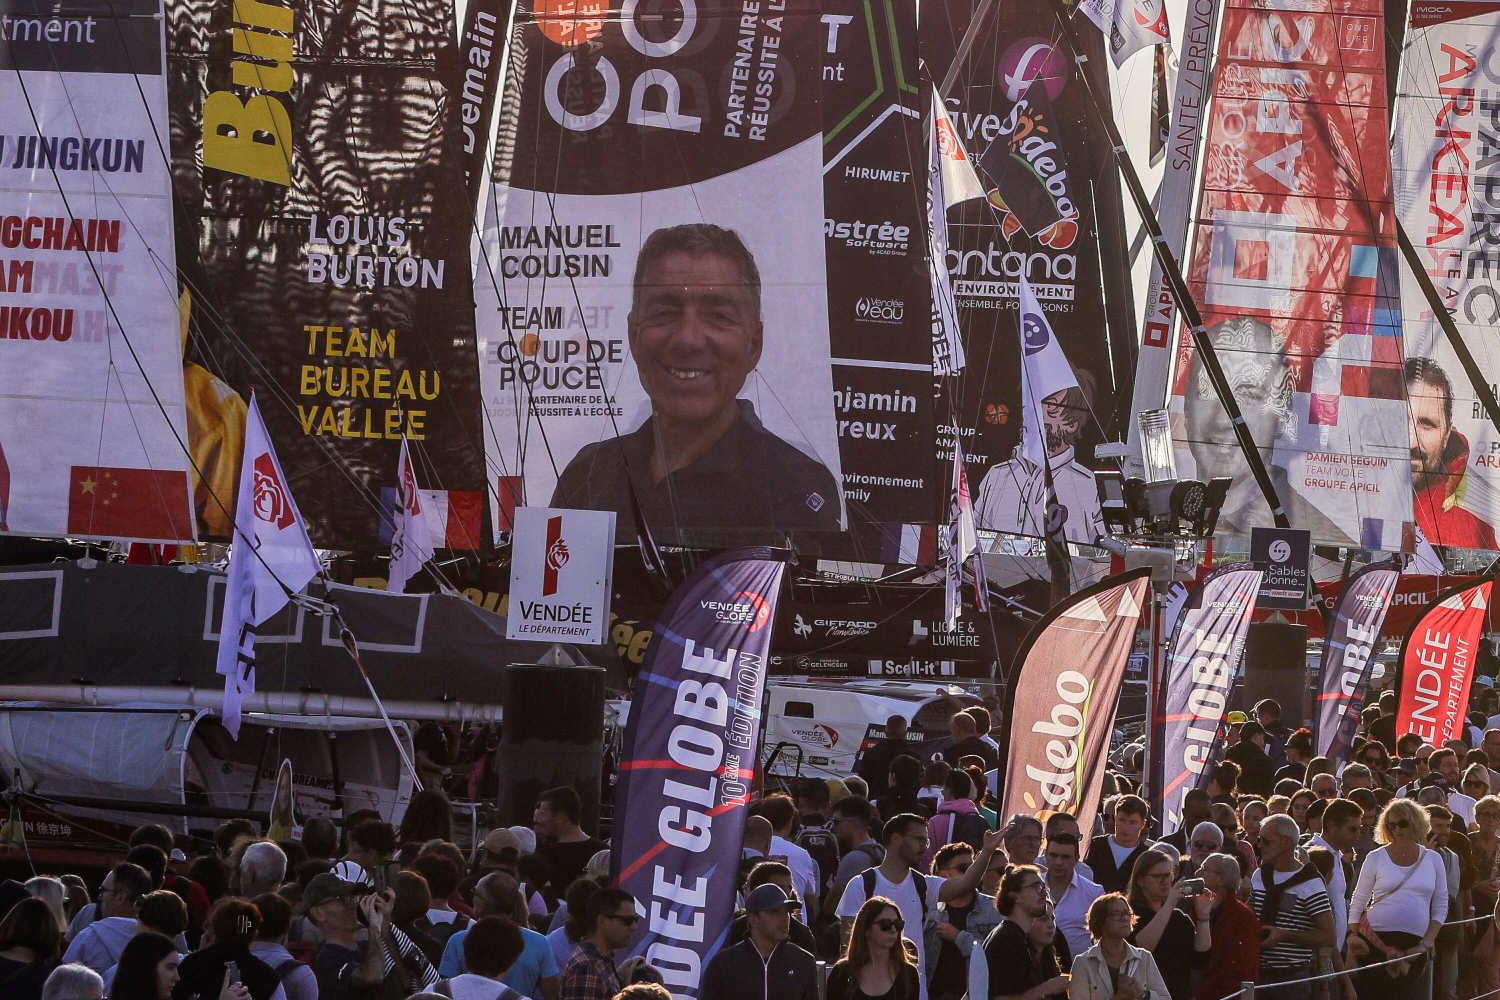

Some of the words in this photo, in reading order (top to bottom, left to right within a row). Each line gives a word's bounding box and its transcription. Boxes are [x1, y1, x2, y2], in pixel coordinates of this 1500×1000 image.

[724, 1, 760, 138] PARTENAIRE
[746, 35, 780, 141] RÉUSSITE
[1172, 99, 1201, 173] SANTÉ
[12, 136, 145, 173] JINGKUN
[845, 165, 911, 183] HIRUMET
[308, 214, 407, 247] LOUIS
[500, 224, 621, 249] MANUEL
[846, 239, 909, 250] Software
[307, 253, 445, 289] BURTON
[502, 254, 611, 278] COUSIN
[869, 306, 904, 320] eau
[871, 297, 904, 307] Vendée
[497, 307, 562, 330] TEAM
[303, 326, 397, 360] TEAM
[585, 340, 623, 363] DE
[301, 366, 441, 401] BUREAU
[500, 360, 601, 390] POUCE
[527, 405, 574, 416] RÉUSSITE
[528, 396, 587, 405] PARTENAIRE
[589, 396, 602, 404] DE
[297, 398, 427, 440] VALLÉE
[1305, 464, 1332, 476] TEAM
[1306, 452, 1348, 464] DAMIEN
[1350, 456, 1388, 468] SEGUIN
[1304, 478, 1347, 489] GROUPE
[1349, 481, 1381, 493] APICIL
[1269, 565, 1306, 577] Sables
[520, 600, 593, 624] VENDÉE
[518, 624, 529, 634] LE
[530, 624, 591, 637] DÉPARTEMENT
[814, 619, 878, 630] GIFFARD
[967, 621, 975, 632] &
[932, 634, 980, 647] LUMIÈRE
[724, 651, 762, 750] ÉDITION
[1409, 628, 1452, 750] ENDÉE
[658, 638, 738, 853] GLOBE
